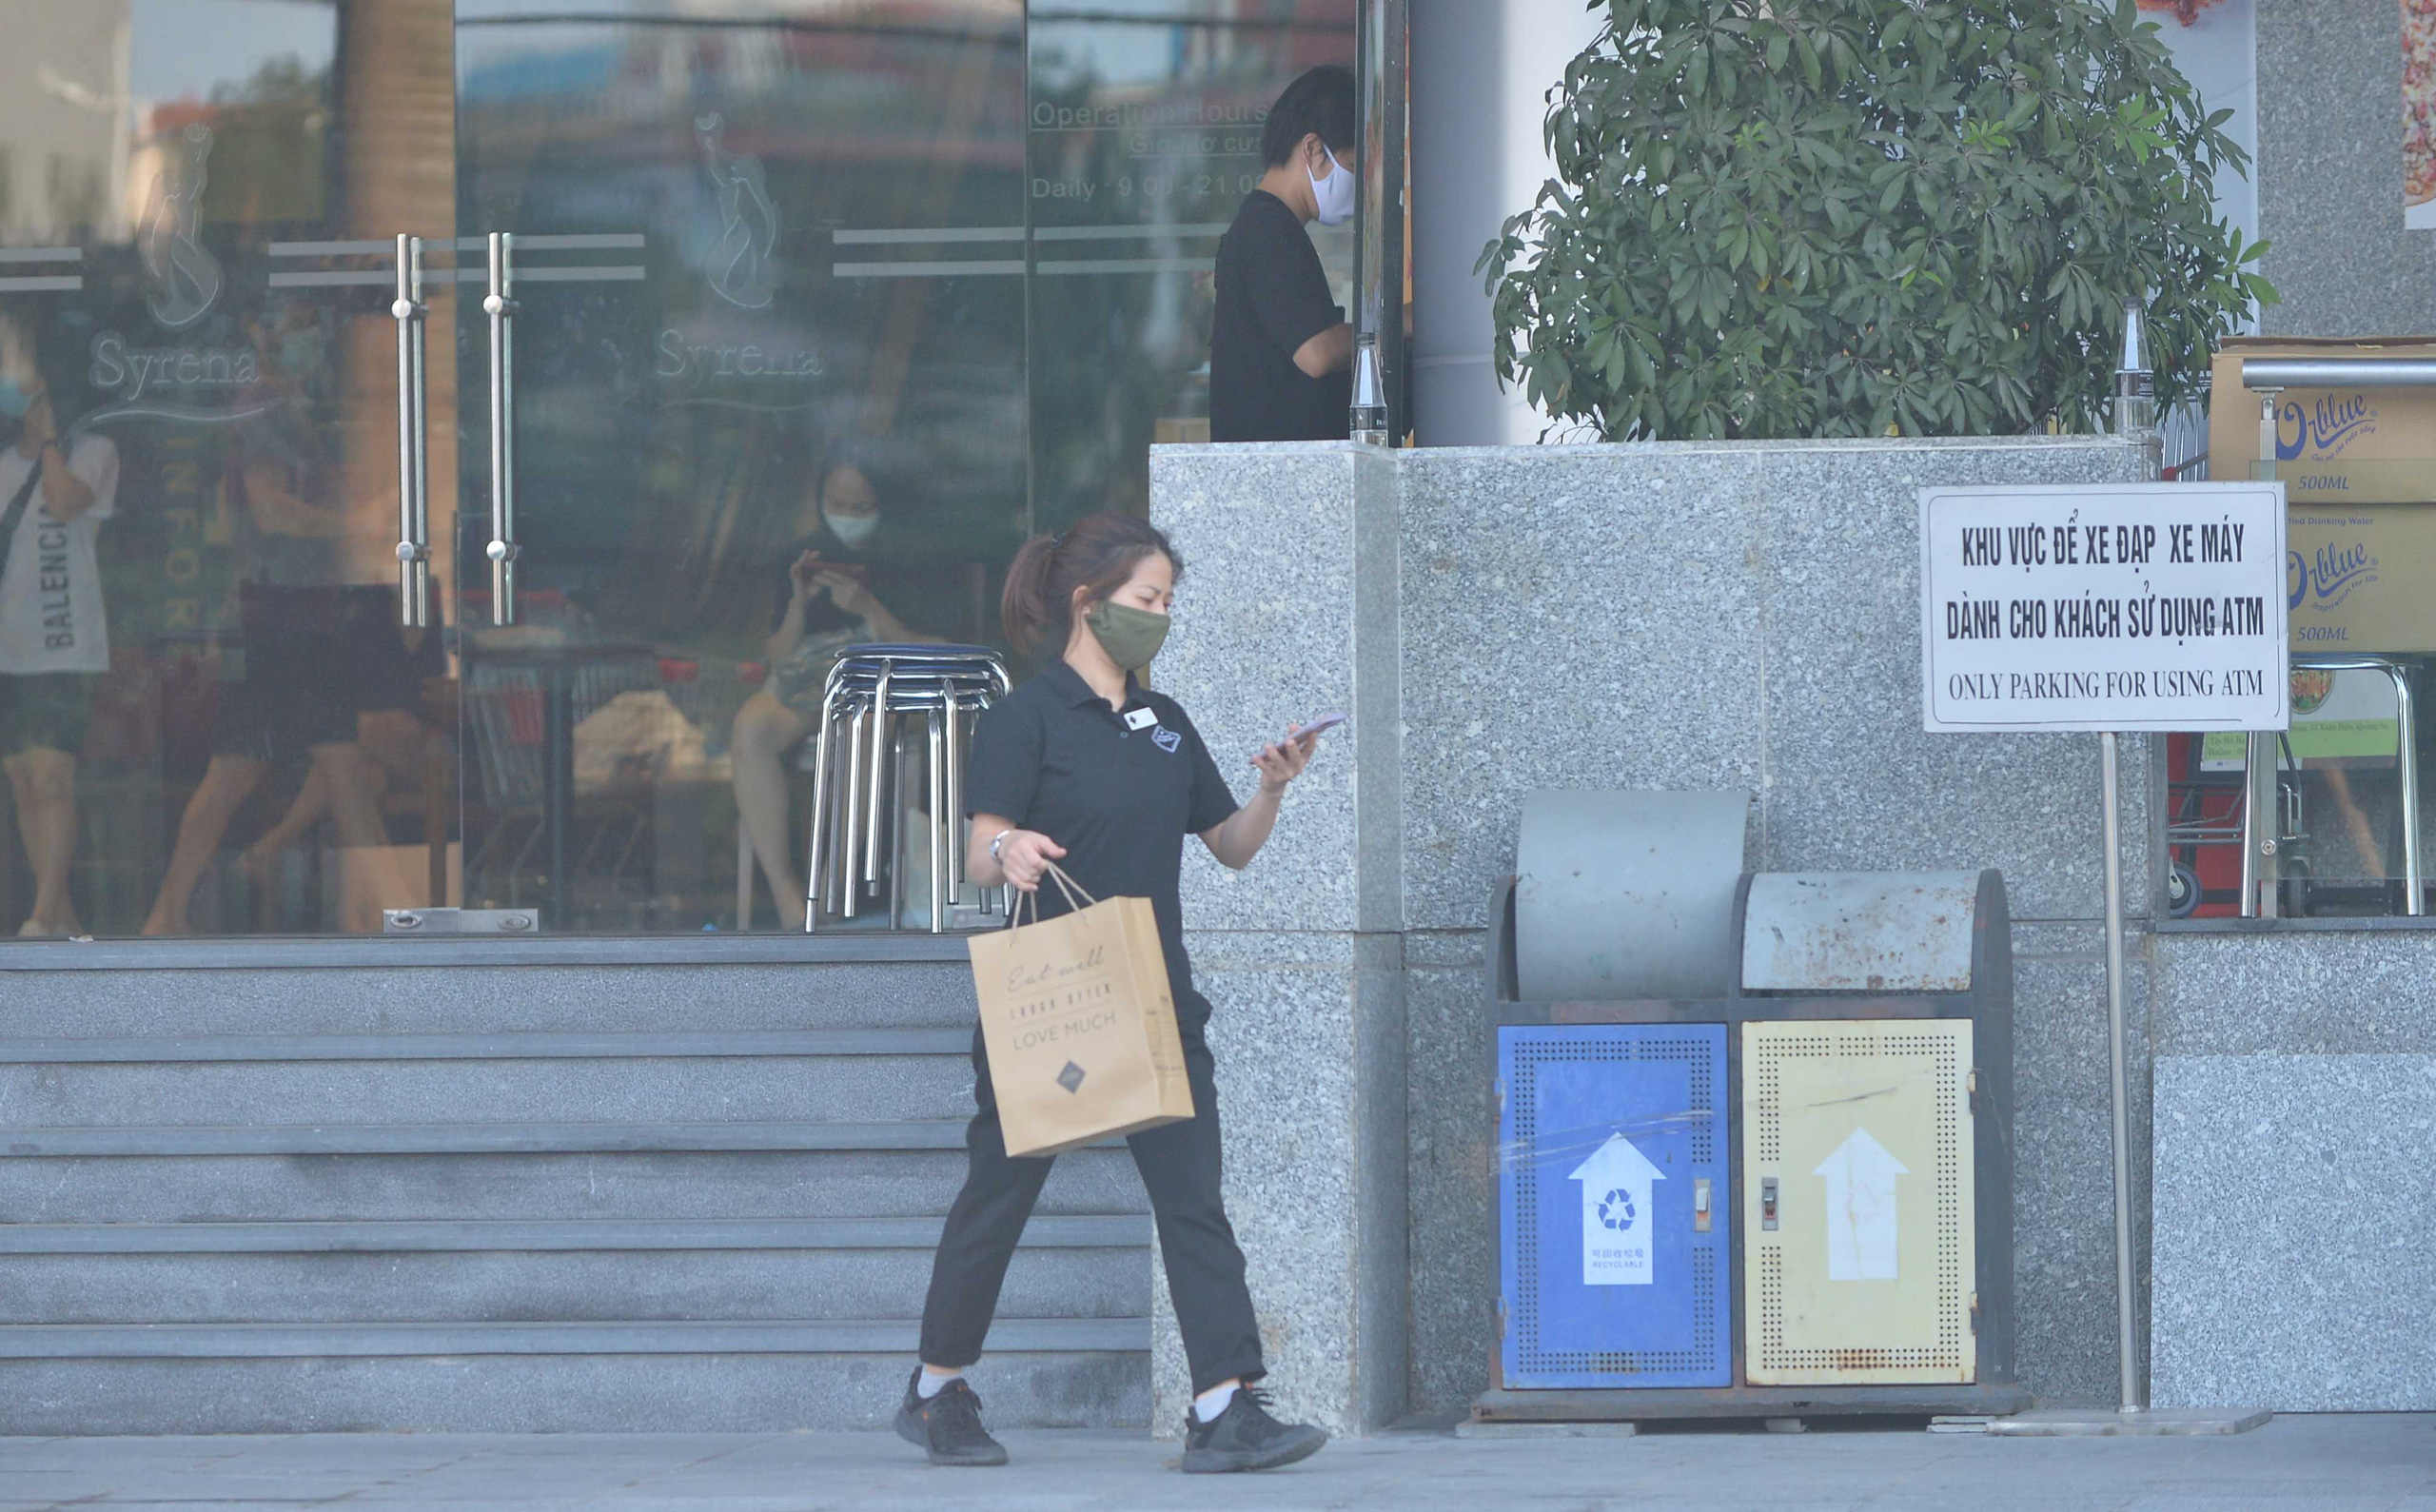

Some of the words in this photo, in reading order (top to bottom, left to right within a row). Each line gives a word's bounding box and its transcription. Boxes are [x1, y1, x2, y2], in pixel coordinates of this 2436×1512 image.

[1032, 101, 1176, 128] Operation
[1031, 178, 1096, 202] Daily
[94, 339, 260, 401] Syrena
[658, 329, 823, 388] Syrena
[2297, 476, 2349, 489] 500ML
[2308, 517, 2346, 527] Drinking
[2348, 517, 2374, 525] Water
[1962, 526, 2001, 567] KHU
[2008, 522, 2047, 573] VỰC
[2053, 508, 2080, 566] ĐỂ
[2085, 524, 2110, 564] XE
[2116, 524, 2156, 573] ĐẠP
[2170, 523, 2194, 563] XE
[2201, 515, 2245, 563] MÁY
[1947, 591, 2001, 639] DÀNH
[2010, 599, 2047, 639] CHO
[2054, 590, 2121, 638] KHÁCH
[2128, 580, 2156, 638] SỬ
[2161, 596, 2215, 645] DỤNG
[2222, 597, 2264, 636] ATM
[2297, 627, 2349, 641] 500ML
[1949, 672, 2003, 700] ONLY
[2010, 672, 2099, 699] PARKING
[2106, 671, 2147, 698] FOR
[2153, 669, 2215, 697] USING
[2221, 670, 2264, 697] ATM
[1007, 964, 1053, 992] Eat
[1059, 945, 1105, 977] well
[1012, 1027, 1059, 1051] LOVE
[1065, 1010, 1117, 1037] MUCH
[1592, 1261, 1644, 1269] RECYCLABLE
